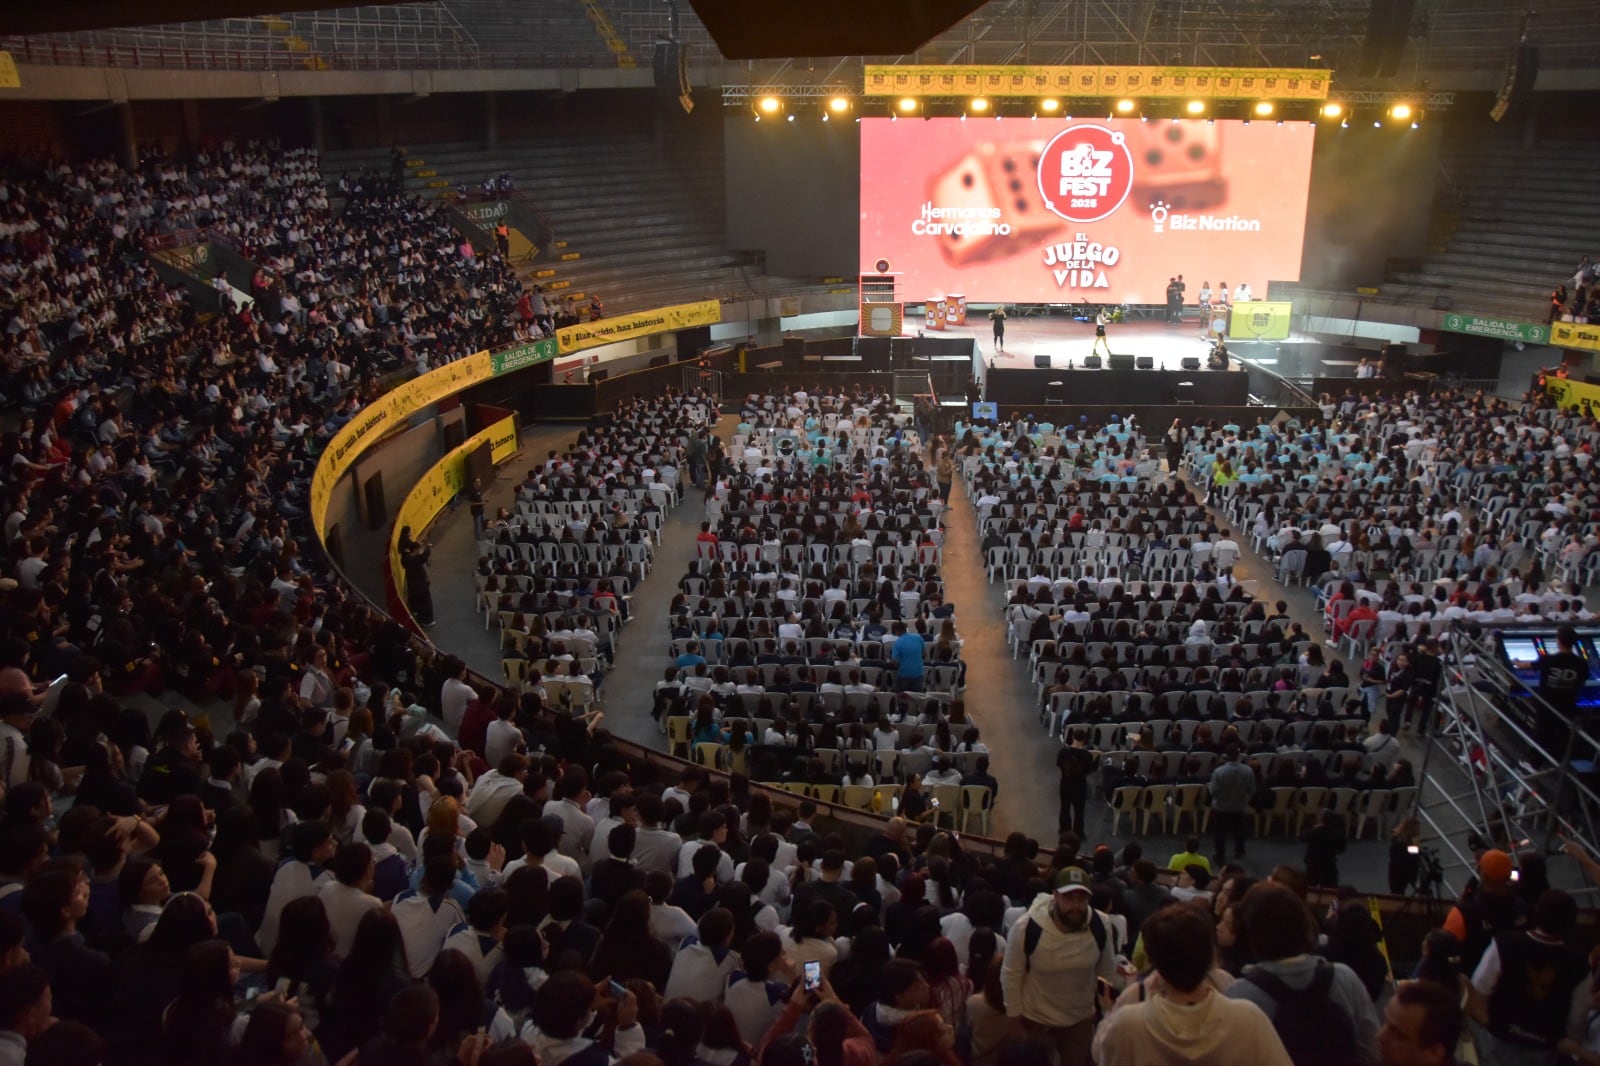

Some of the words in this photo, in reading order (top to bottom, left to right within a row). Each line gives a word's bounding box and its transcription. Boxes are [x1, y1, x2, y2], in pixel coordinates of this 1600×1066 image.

[1060, 178, 1111, 196] FEST
[1076, 232, 1088, 241] EL
[1044, 242, 1119, 266] JUEGO
[1066, 261, 1080, 269] DE
[1081, 261, 1095, 269] LA
[1053, 270, 1110, 287] VIDA
[616, 323, 632, 333] haz
[632, 317, 664, 330] historia
[1452, 318, 1459, 327] 3
[1473, 319, 1504, 329] SALIDA
[1465, 325, 1523, 338] EMERGENCIA
[1532, 329, 1540, 339] 3
[504, 349, 526, 361] SALIDA
[527, 346, 536, 354] DE
[546, 344, 551, 354] 2
[500, 352, 541, 370] EMERGENCIA
[1547, 668, 1577, 681] 3D
